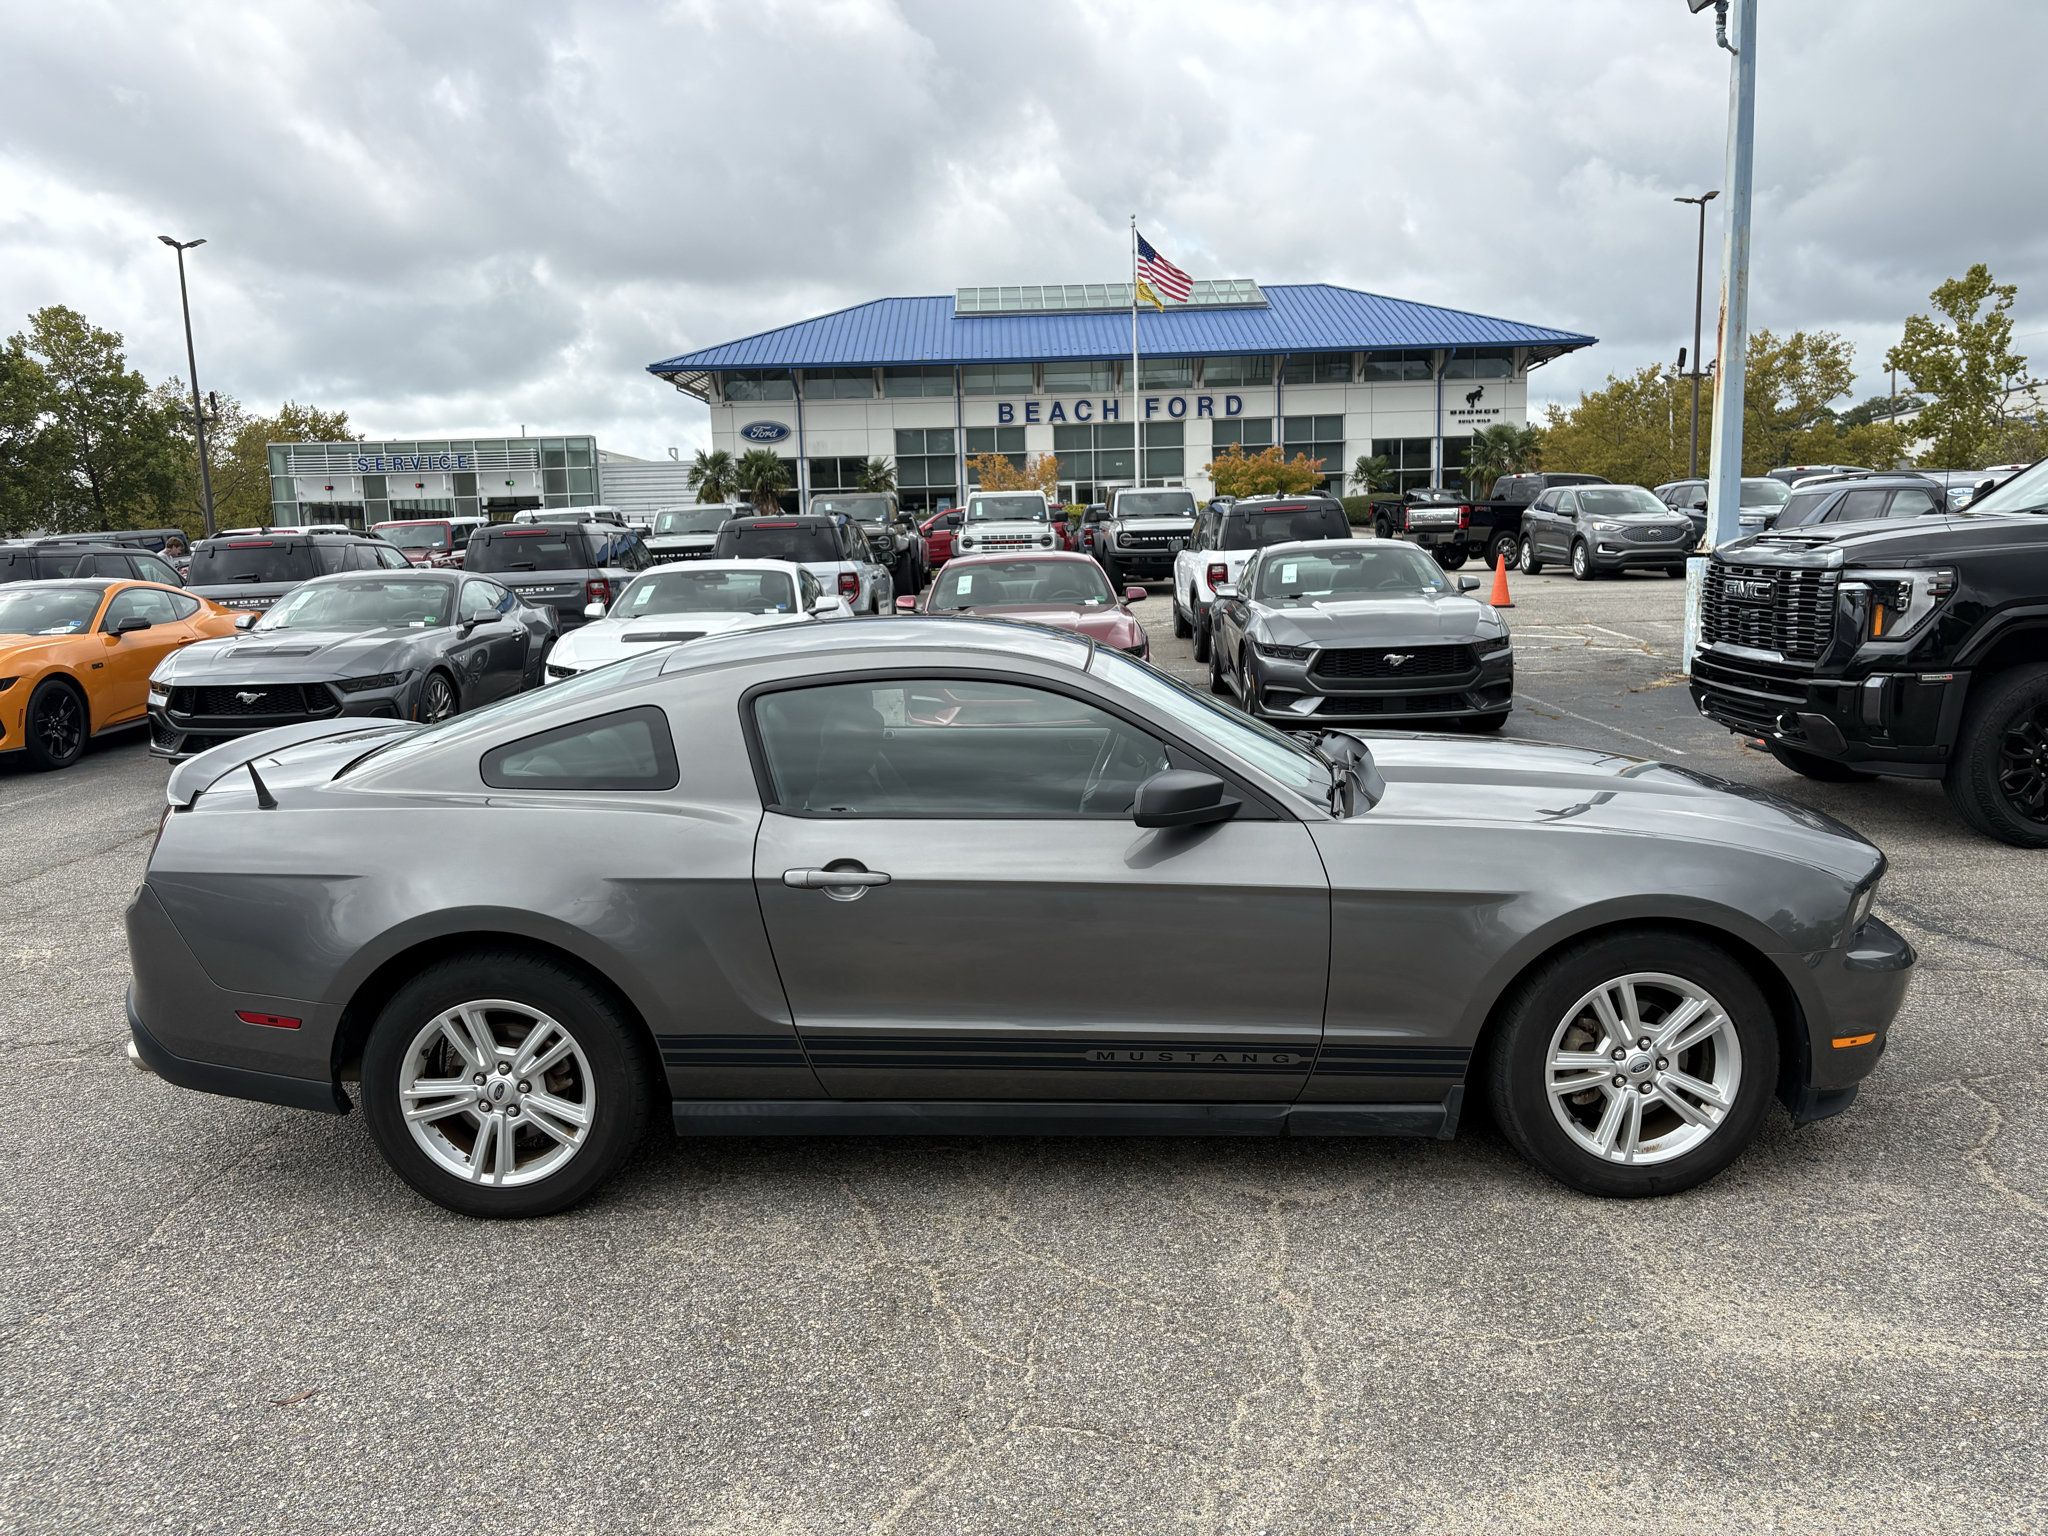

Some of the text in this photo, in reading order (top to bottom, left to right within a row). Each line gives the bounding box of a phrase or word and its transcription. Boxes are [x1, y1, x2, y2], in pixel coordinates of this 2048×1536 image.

[998, 394, 1243, 424] BEACH FORD
[1450, 408, 1500, 416] BRONCO
[357, 455, 469, 472] SERVICE
[1723, 579, 1771, 599] GMC
[1096, 1051, 1290, 1064] MUSTANG
